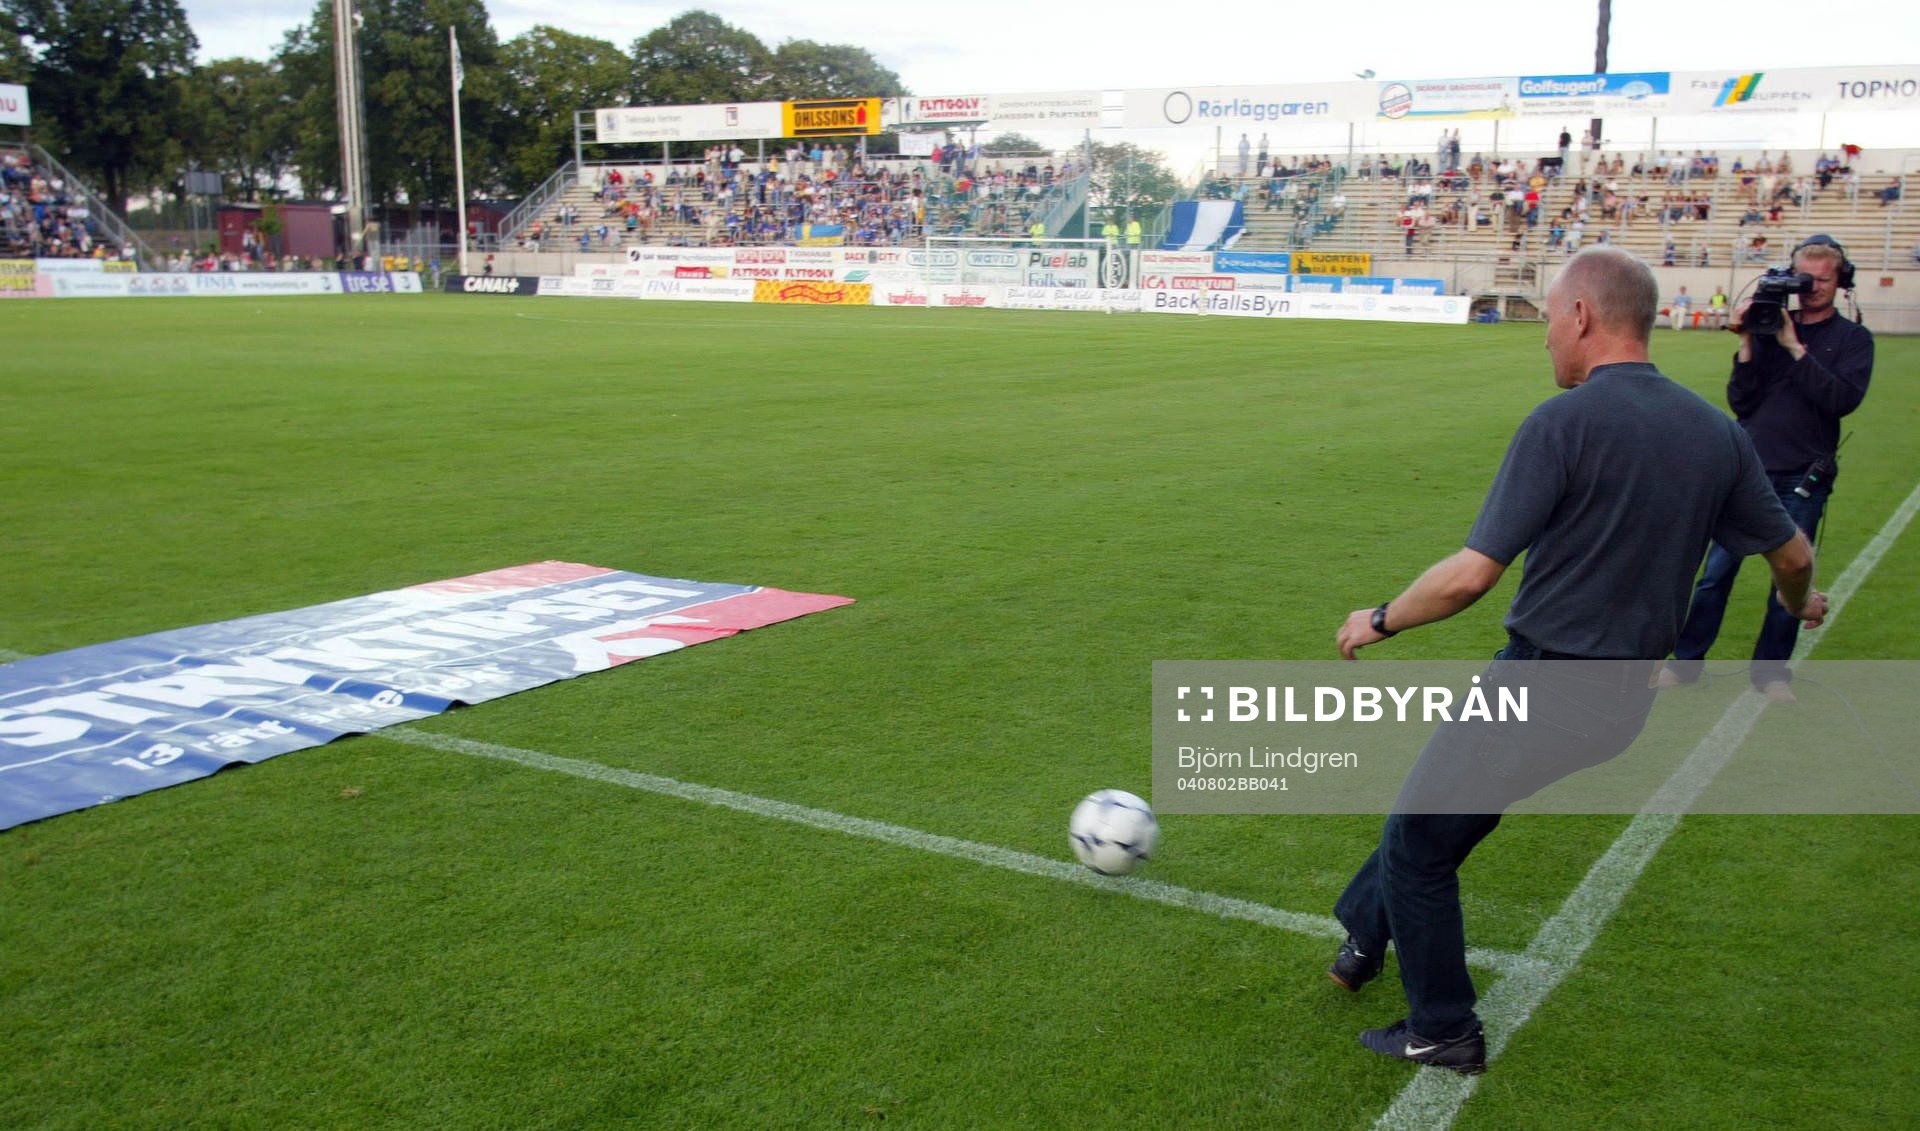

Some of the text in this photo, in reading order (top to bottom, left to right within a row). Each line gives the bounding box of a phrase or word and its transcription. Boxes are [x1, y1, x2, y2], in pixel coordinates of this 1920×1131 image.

[1521, 78, 1607, 95] Golfsugen?
[1838, 80, 1920, 99] TOPNO
[919, 98, 980, 110] FLYTGOLV
[1198, 98, 1329, 120] Rörläggaren
[793, 110, 855, 127] OHLSSONS
[785, 268, 834, 278] FLYTGOLV
[346, 274, 391, 292] tre.se
[463, 277, 520, 293] CANAL+
[648, 280, 681, 294] FINJA
[1141, 275, 1166, 289] ICA
[0, 580, 704, 747] STRYKTIPSET
[112, 719, 297, 771] 13 rätt
